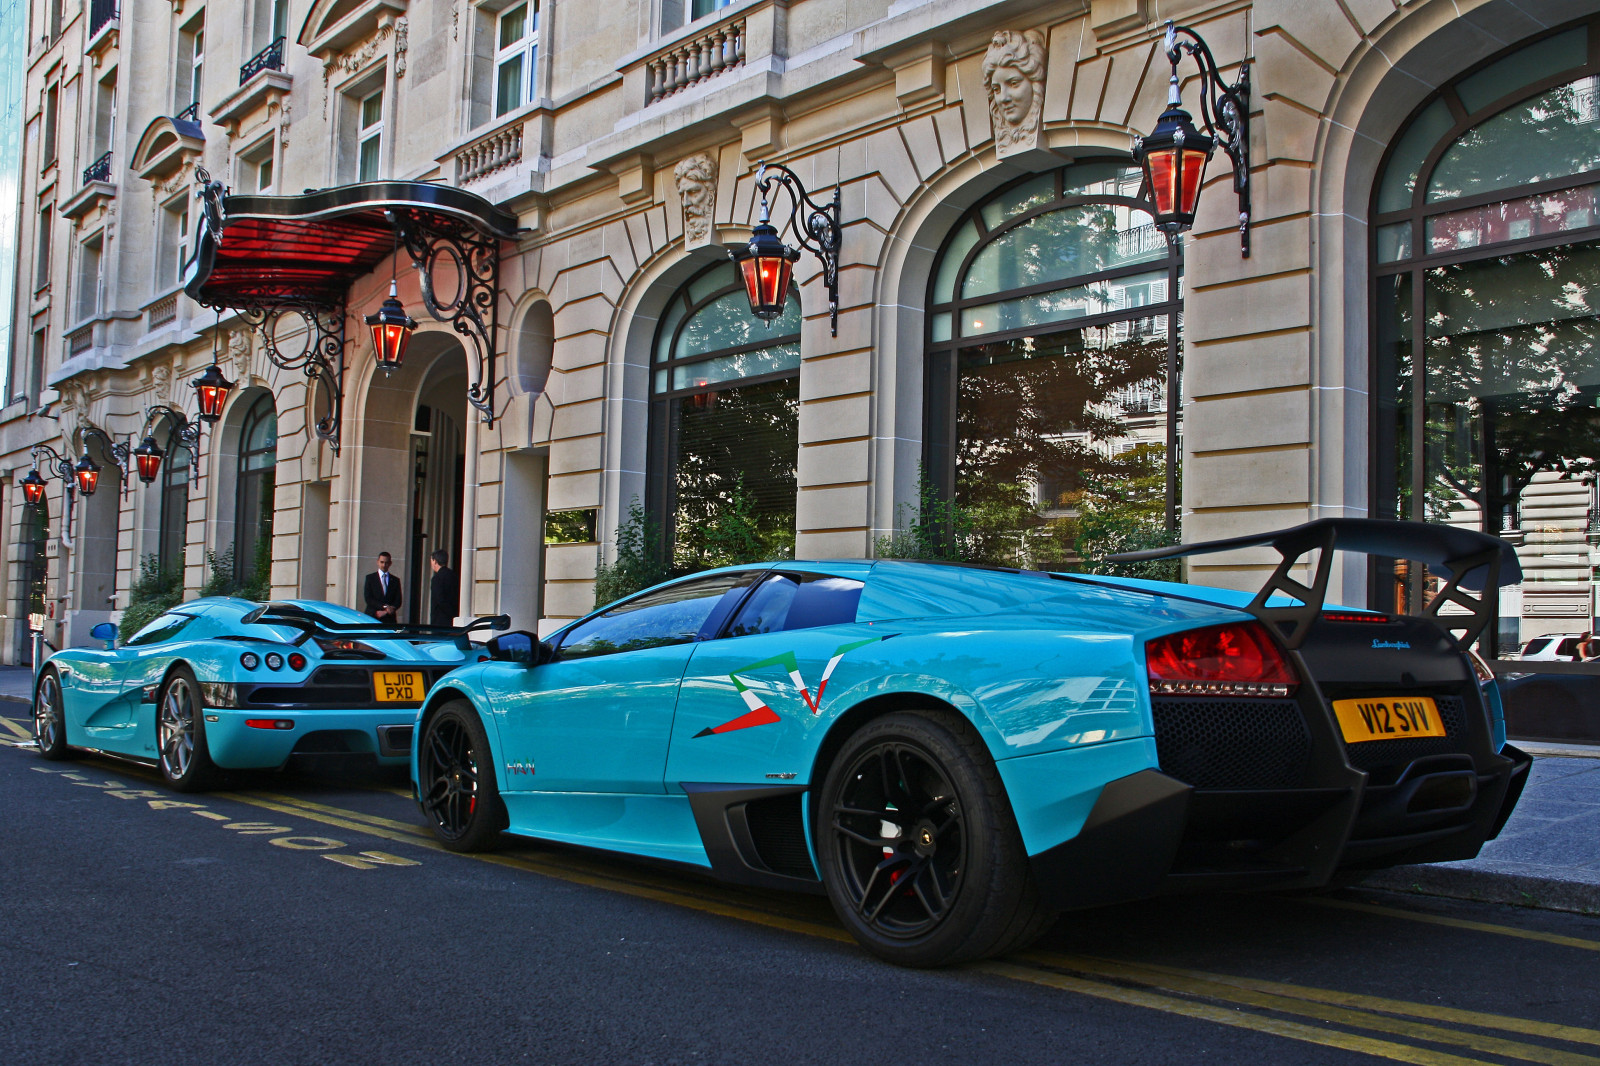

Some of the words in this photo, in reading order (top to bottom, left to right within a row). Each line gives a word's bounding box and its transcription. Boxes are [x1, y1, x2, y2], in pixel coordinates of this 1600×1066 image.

[383, 674, 413, 685] LJ10
[386, 687, 413, 699] PXD
[1357, 702, 1396, 734] V12
[1393, 701, 1429, 732] SVV
